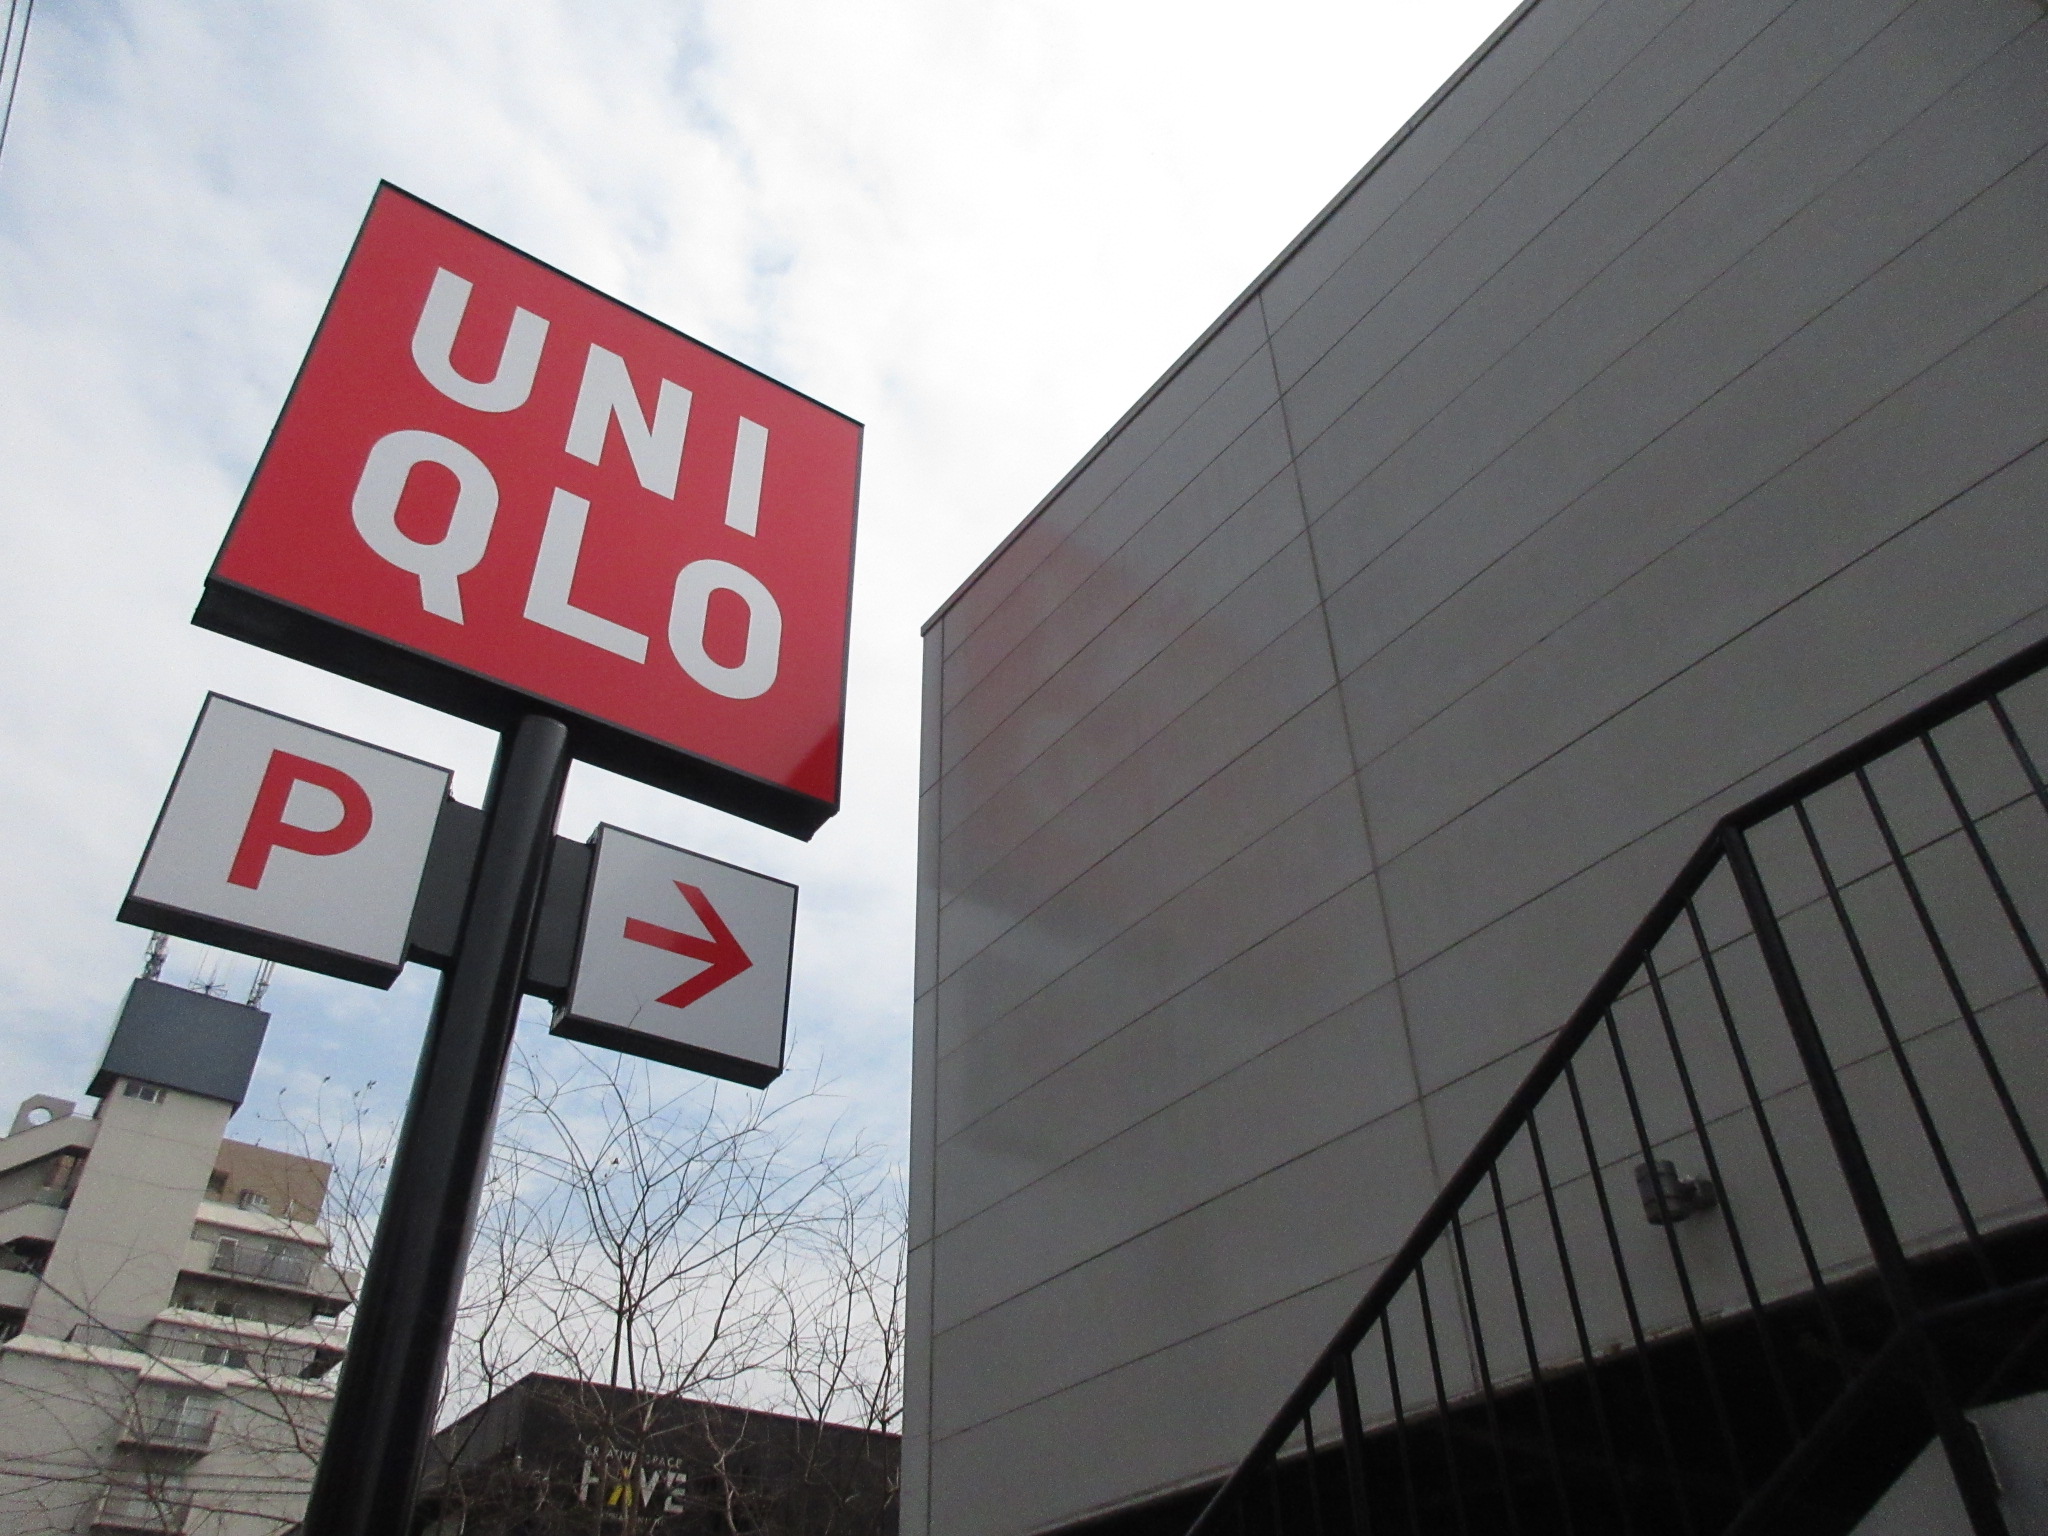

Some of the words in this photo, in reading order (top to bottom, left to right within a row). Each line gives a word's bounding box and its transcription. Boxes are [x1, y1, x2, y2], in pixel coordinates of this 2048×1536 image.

[410, 266, 770, 538] UNI
[351, 429, 783, 700] QLO
[227, 749, 373, 890] P
[585, 1445, 638, 1460] CRATIVE
